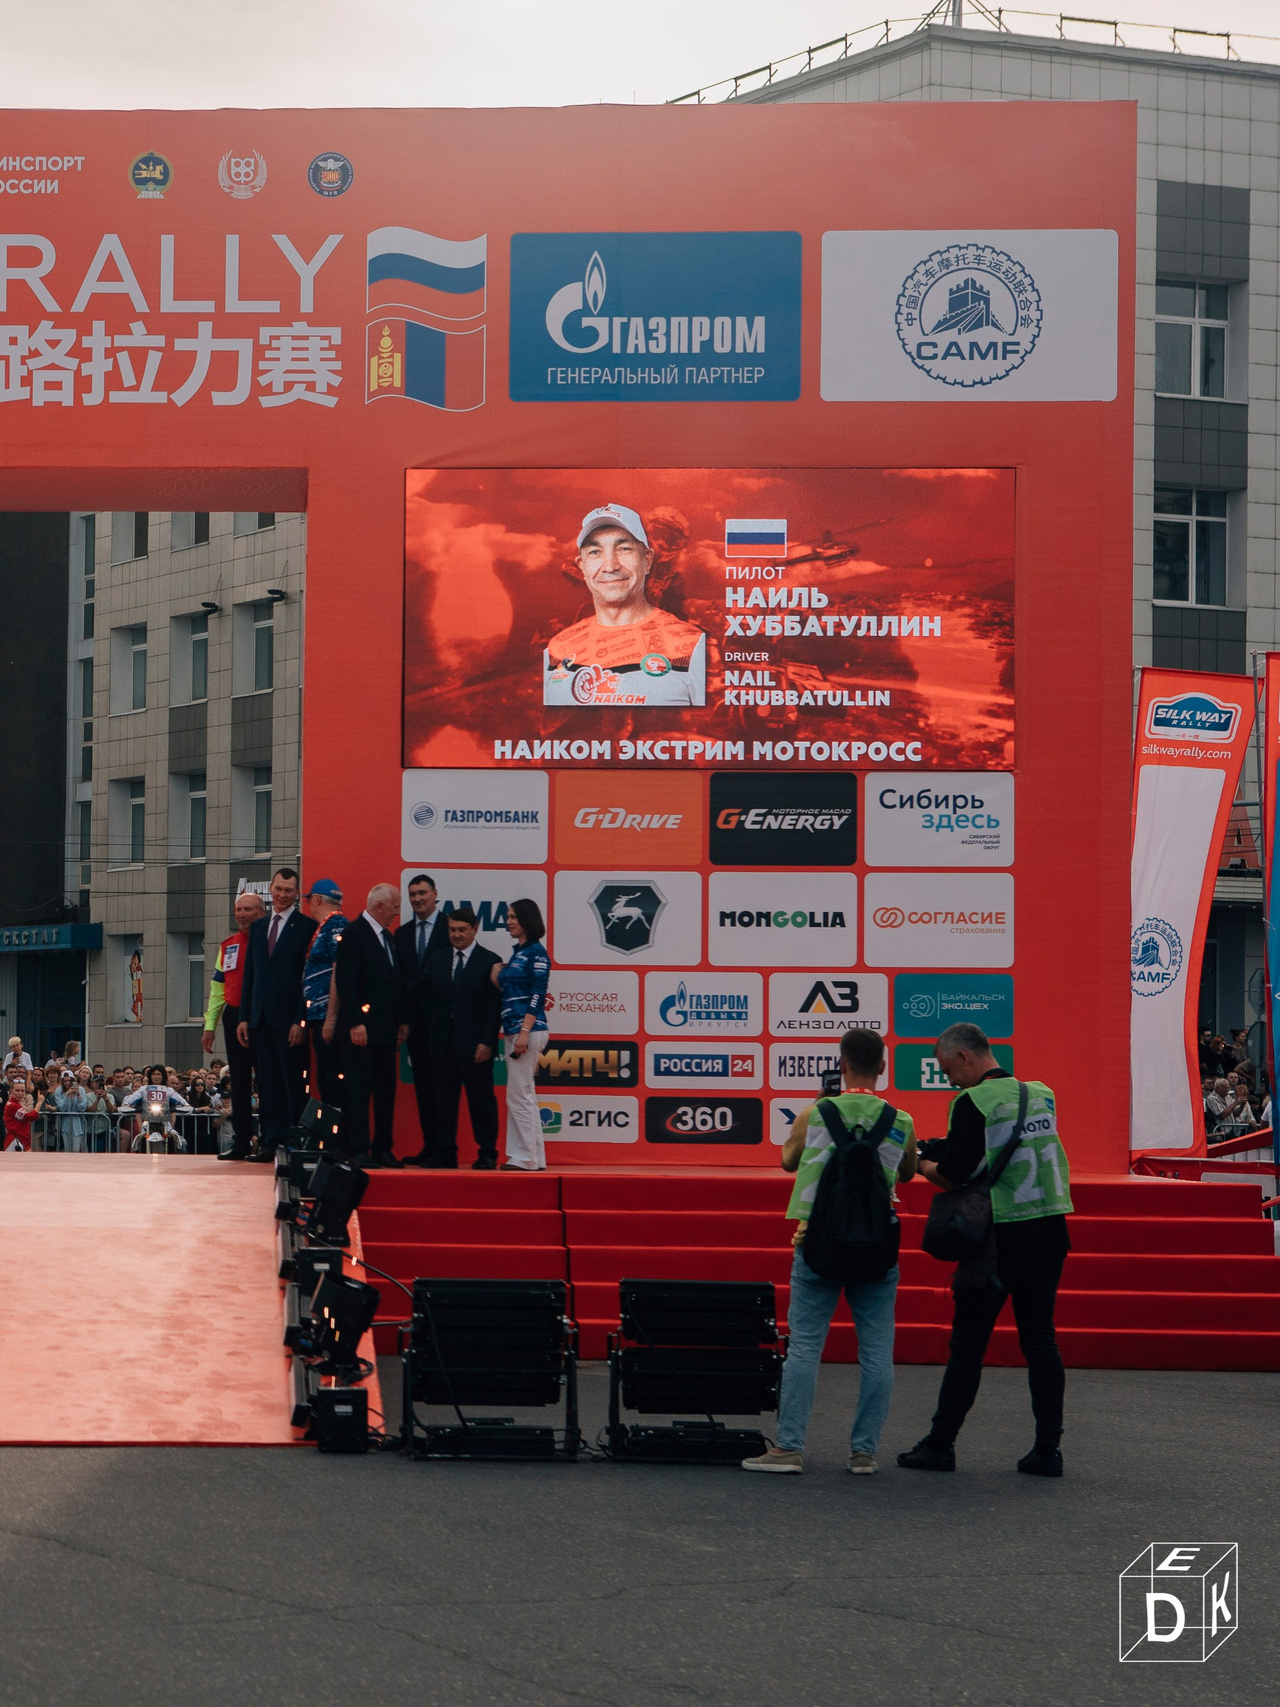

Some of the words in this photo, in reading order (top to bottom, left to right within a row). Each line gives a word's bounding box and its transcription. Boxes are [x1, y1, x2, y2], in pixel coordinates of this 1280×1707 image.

[904, 253, 1034, 329] 中国汽车摩托车运动联合会
[611, 315, 766, 354] ГАЗПРОМ
[916, 341, 1022, 361] CAMF
[547, 363, 679, 385] ГЕНЕРАЛЬНЫЙ
[685, 367, 766, 384] ПАРТНЕР
[724, 566, 786, 580] ПИЛОТ
[724, 586, 830, 609] НАИЛЬ
[724, 614, 943, 638] ХУББАТУЛЛИН
[724, 651, 770, 662] DRIVER
[724, 669, 777, 687] NAIL
[593, 693, 648, 705] NAIKOM
[724, 688, 892, 708] KHUBBATULLIN
[1155, 708, 1195, 720] SILK
[1195, 710, 1231, 723] WAY
[1171, 719, 1211, 727] RALLY
[494, 739, 612, 761] НАИКОМ
[618, 739, 746, 762] ЭКСТРИМ
[752, 740, 923, 763] МОТОКРОСС
[1141, 743, 1232, 760] silkwayrally.com
[879, 788, 985, 815] Сибирь
[444, 809, 540, 824] ГАЗПРОМБАНК
[921, 812, 1001, 833] здесь
[719, 910, 846, 928] MONGOLIA
[907, 911, 1006, 925] СОГЛАСИЕ
[949, 926, 1006, 935] страхование
[559, 992, 618, 1002] РУССКАЯ
[688, 994, 749, 1010] ГАЗПРОМ
[941, 993, 1006, 1001] БАЙКАЛЬСК
[559, 1003, 627, 1013] МЕХАНИКА
[941, 1002, 990, 1011] ЭКО.ЦЕХ
[690, 1011, 748, 1019] ДОБЫЧА
[776, 1019, 881, 1030] ЛЕНЗОЛОТО
[660, 1058, 722, 1072] РОССИЯ
[732, 1059, 753, 1072] 24
[150, 1091, 163, 1101] 30
[569, 1110, 630, 1128] 2ГИС
[675, 1106, 733, 1131] 360
[1010, 1142, 1065, 1204] 21
